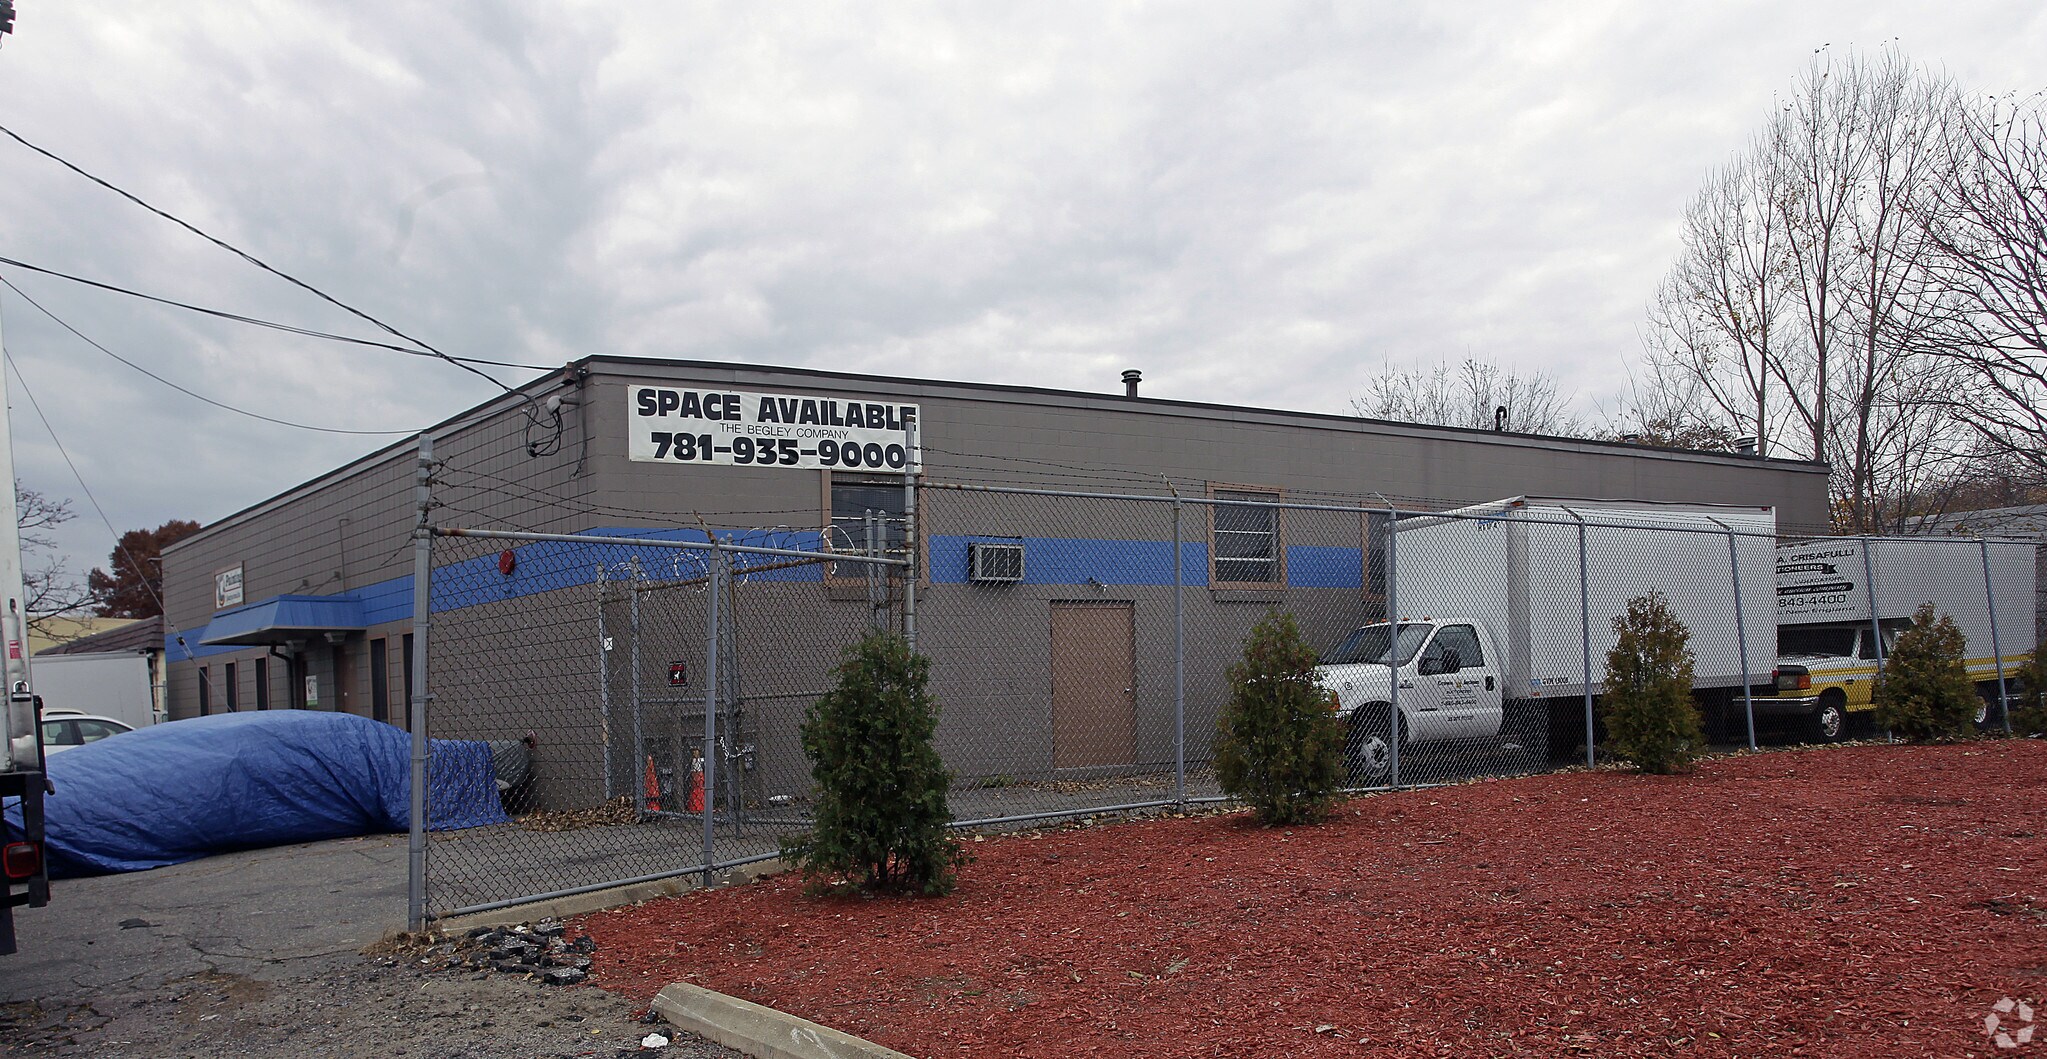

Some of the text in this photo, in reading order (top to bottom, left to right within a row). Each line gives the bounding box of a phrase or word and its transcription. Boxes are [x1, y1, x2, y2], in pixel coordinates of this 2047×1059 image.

[637, 388, 917, 431] SPACE AVAILABLE
[720, 422, 850, 439] THE BEGLEY COMPANY
[651, 431, 907, 469] 781-935-9000
[1791, 549, 1855, 562] CRISAFULLI
